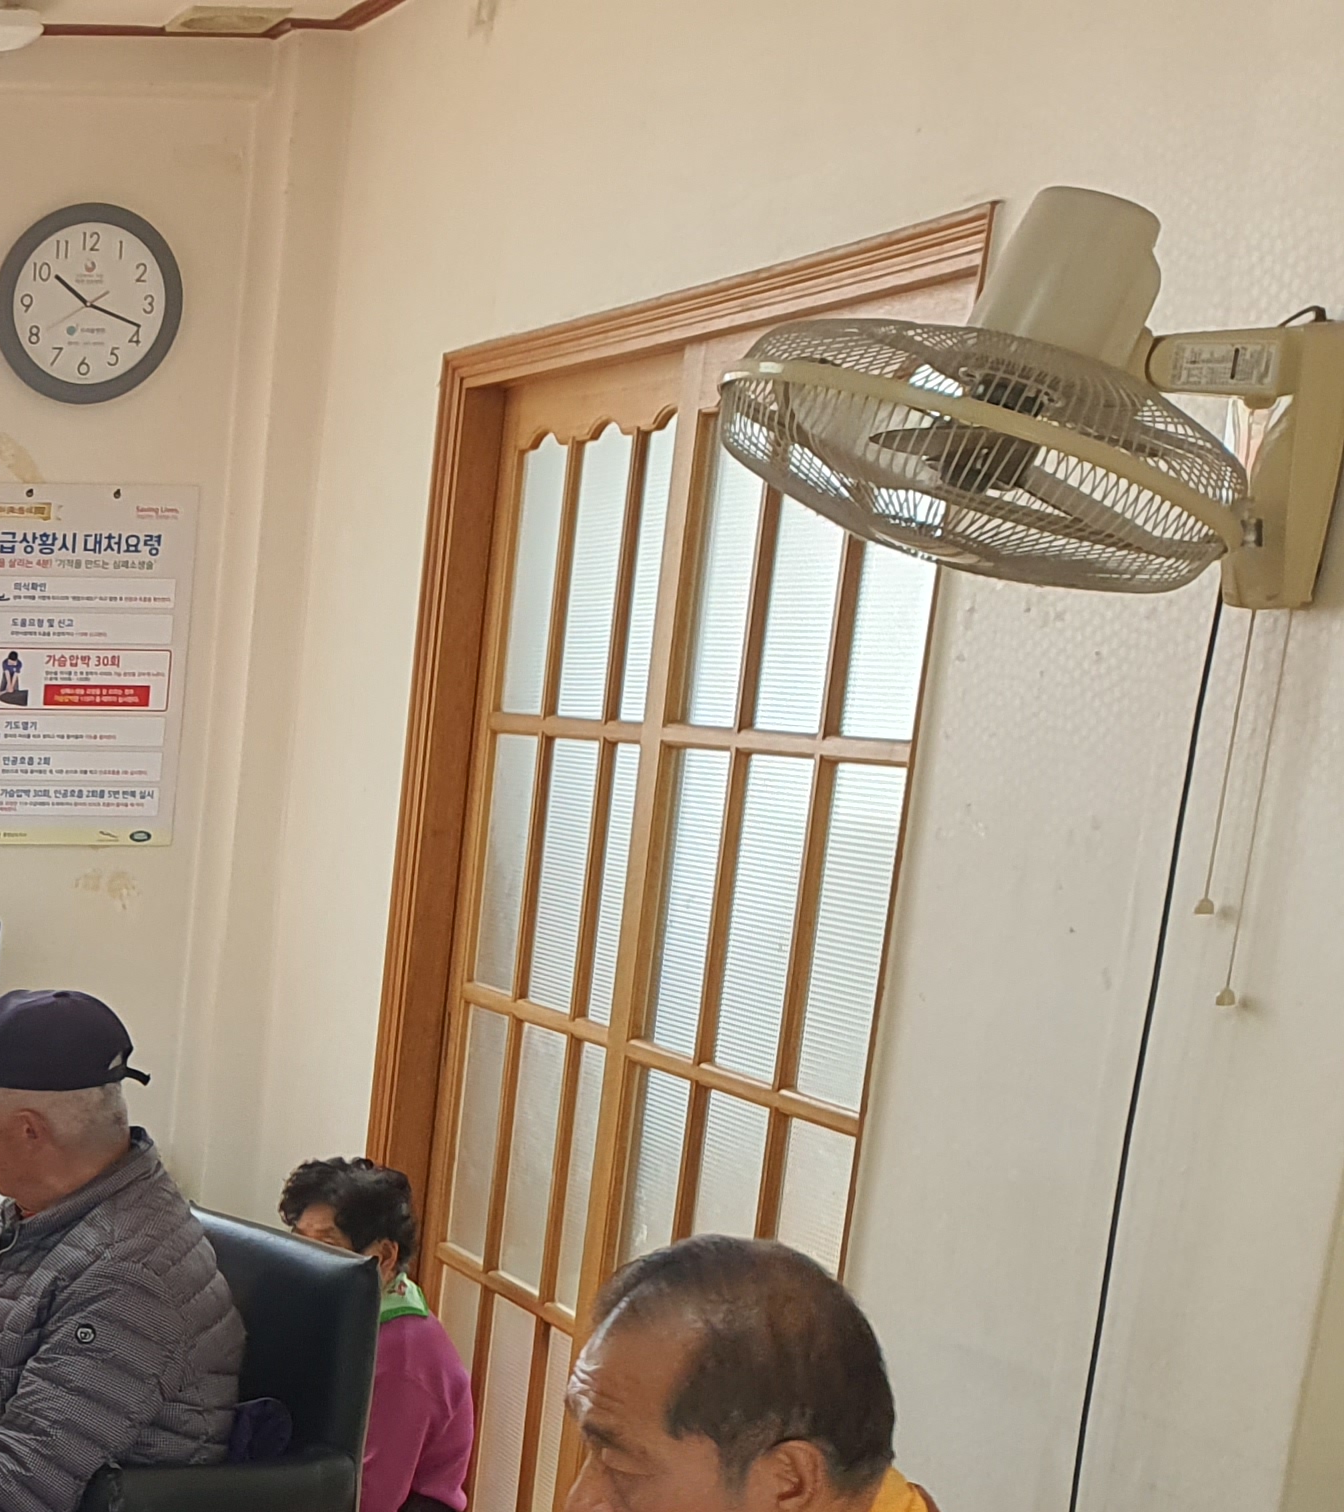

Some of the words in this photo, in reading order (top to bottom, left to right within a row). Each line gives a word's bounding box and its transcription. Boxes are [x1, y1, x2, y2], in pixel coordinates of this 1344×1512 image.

[56, 240, 69, 259] 11
[82, 232, 100, 251] 12
[119, 240, 123, 260] 1
[33, 262, 51, 282] 10
[135, 263, 148, 283] 2
[20, 293, 33, 313] 9
[142, 294, 155, 314] 3
[28, 325, 40, 345] 8
[128, 326, 141, 347] 4
[50, 347, 64, 366] 7
[77, 356, 90, 376] 6
[107, 347, 120, 366] 5
[83, 533, 162, 556] 대처요령
[9, 559, 33, 568] 살리는
[85, 560, 109, 569] 만드는
[14, 582, 47, 592] 의식확인
[58, 619, 74, 628] 신고
[45, 654, 91, 668] 가슴압박
[94, 654, 121, 668] 30회
[4, 721, 37, 731] 기도열기
[2, 756, 35, 766] 인공호흡
[37, 757, 51, 766] 2회
